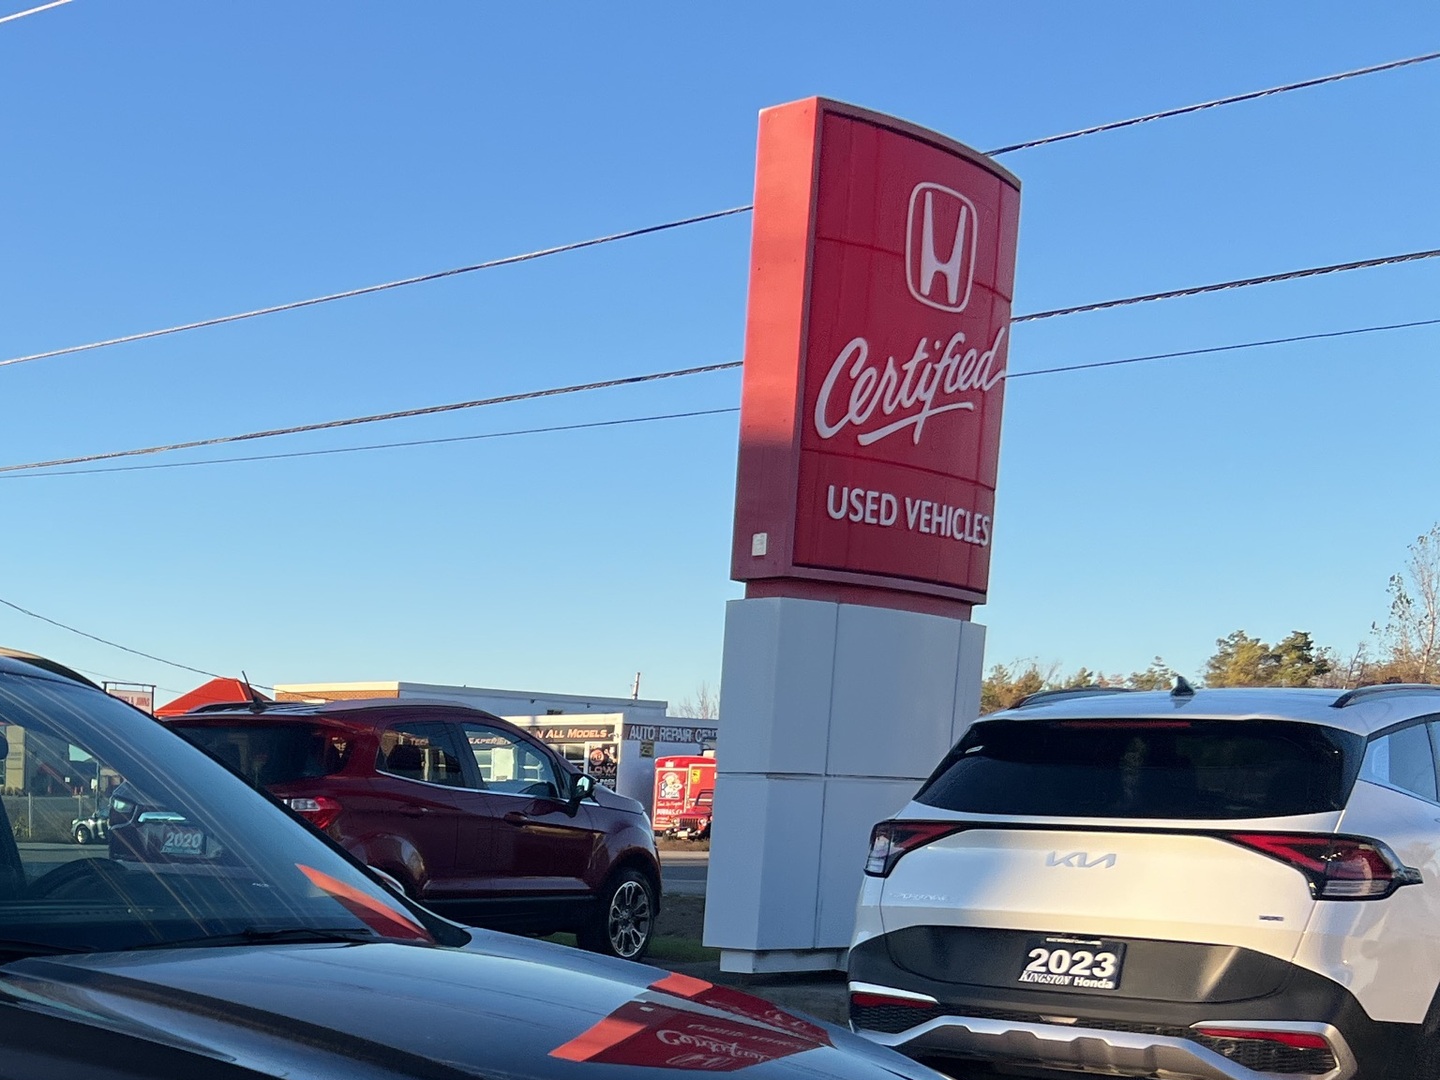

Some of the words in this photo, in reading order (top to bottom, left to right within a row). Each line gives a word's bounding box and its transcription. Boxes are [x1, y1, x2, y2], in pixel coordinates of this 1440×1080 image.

[814, 327, 1005, 445] Certified
[827, 484, 898, 526] USED
[905, 497, 991, 546] VEHICLES
[629, 725, 656, 740] AUTO
[660, 726, 692, 742] REPAIR
[164, 831, 203, 848] 2020
[1025, 948, 1118, 978] 2023
[1073, 976, 1114, 989] Honda
